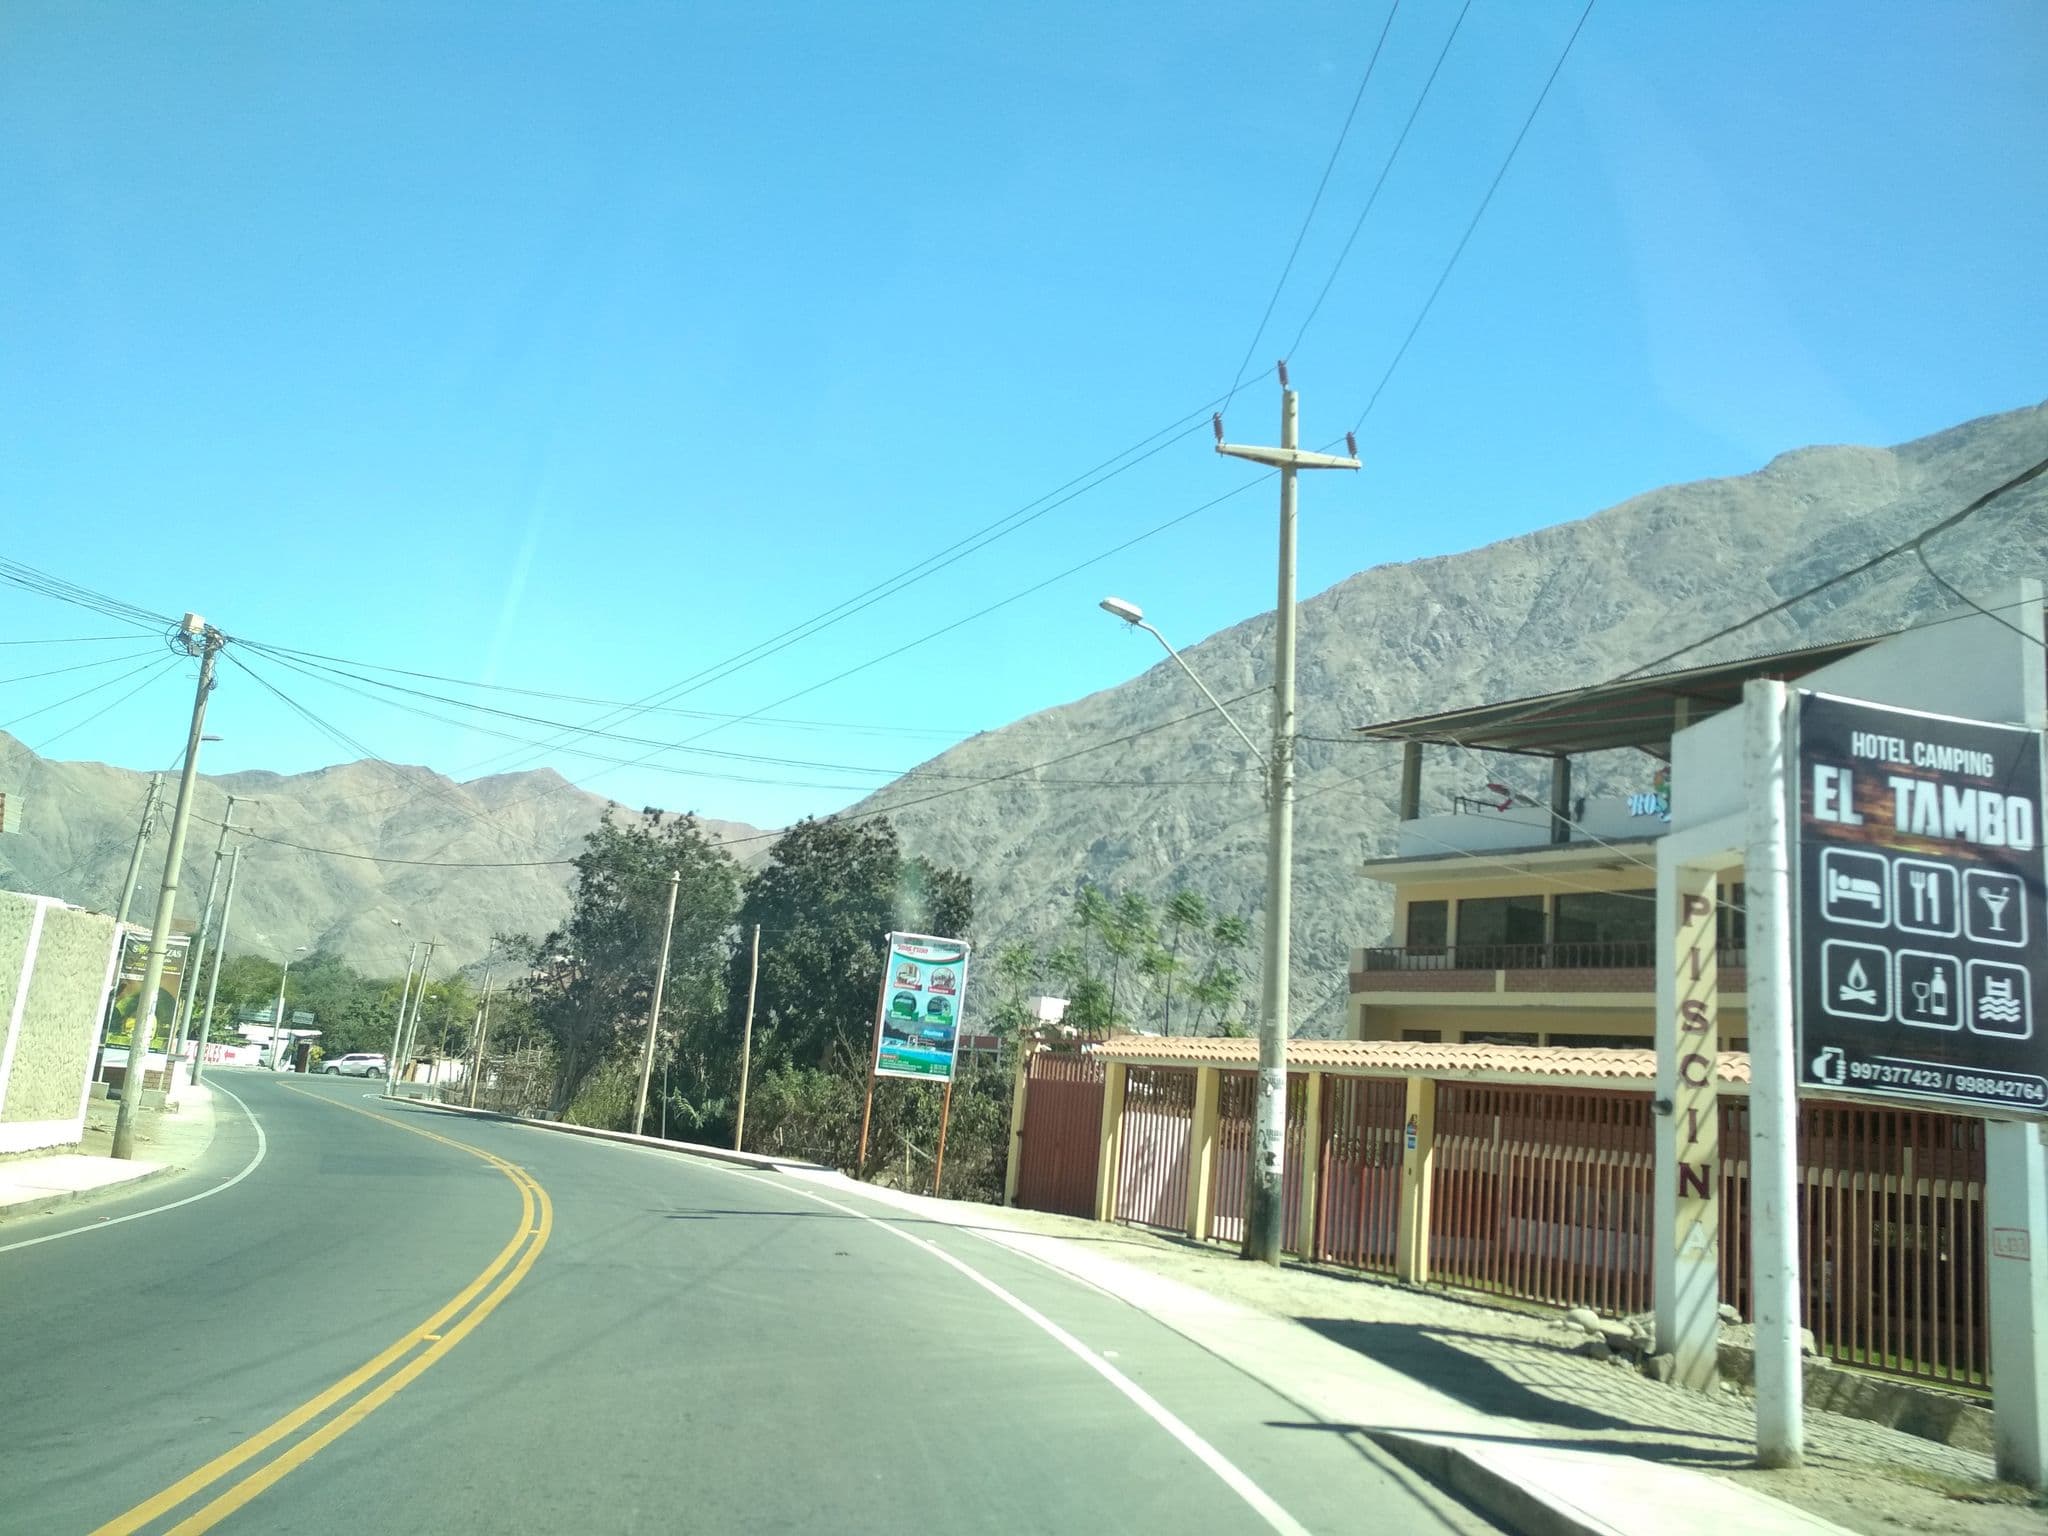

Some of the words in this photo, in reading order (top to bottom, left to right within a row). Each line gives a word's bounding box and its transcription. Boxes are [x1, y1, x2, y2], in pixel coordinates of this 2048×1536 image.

[1852, 731, 1911, 765] HOTEL
[1913, 742, 1995, 778] CAMPING
[1813, 764, 1864, 826] EL
[1888, 776, 2034, 851] TAMBO
[1851, 1062, 1942, 1089] 997377423
[1955, 1075, 2044, 1101] 998842764
